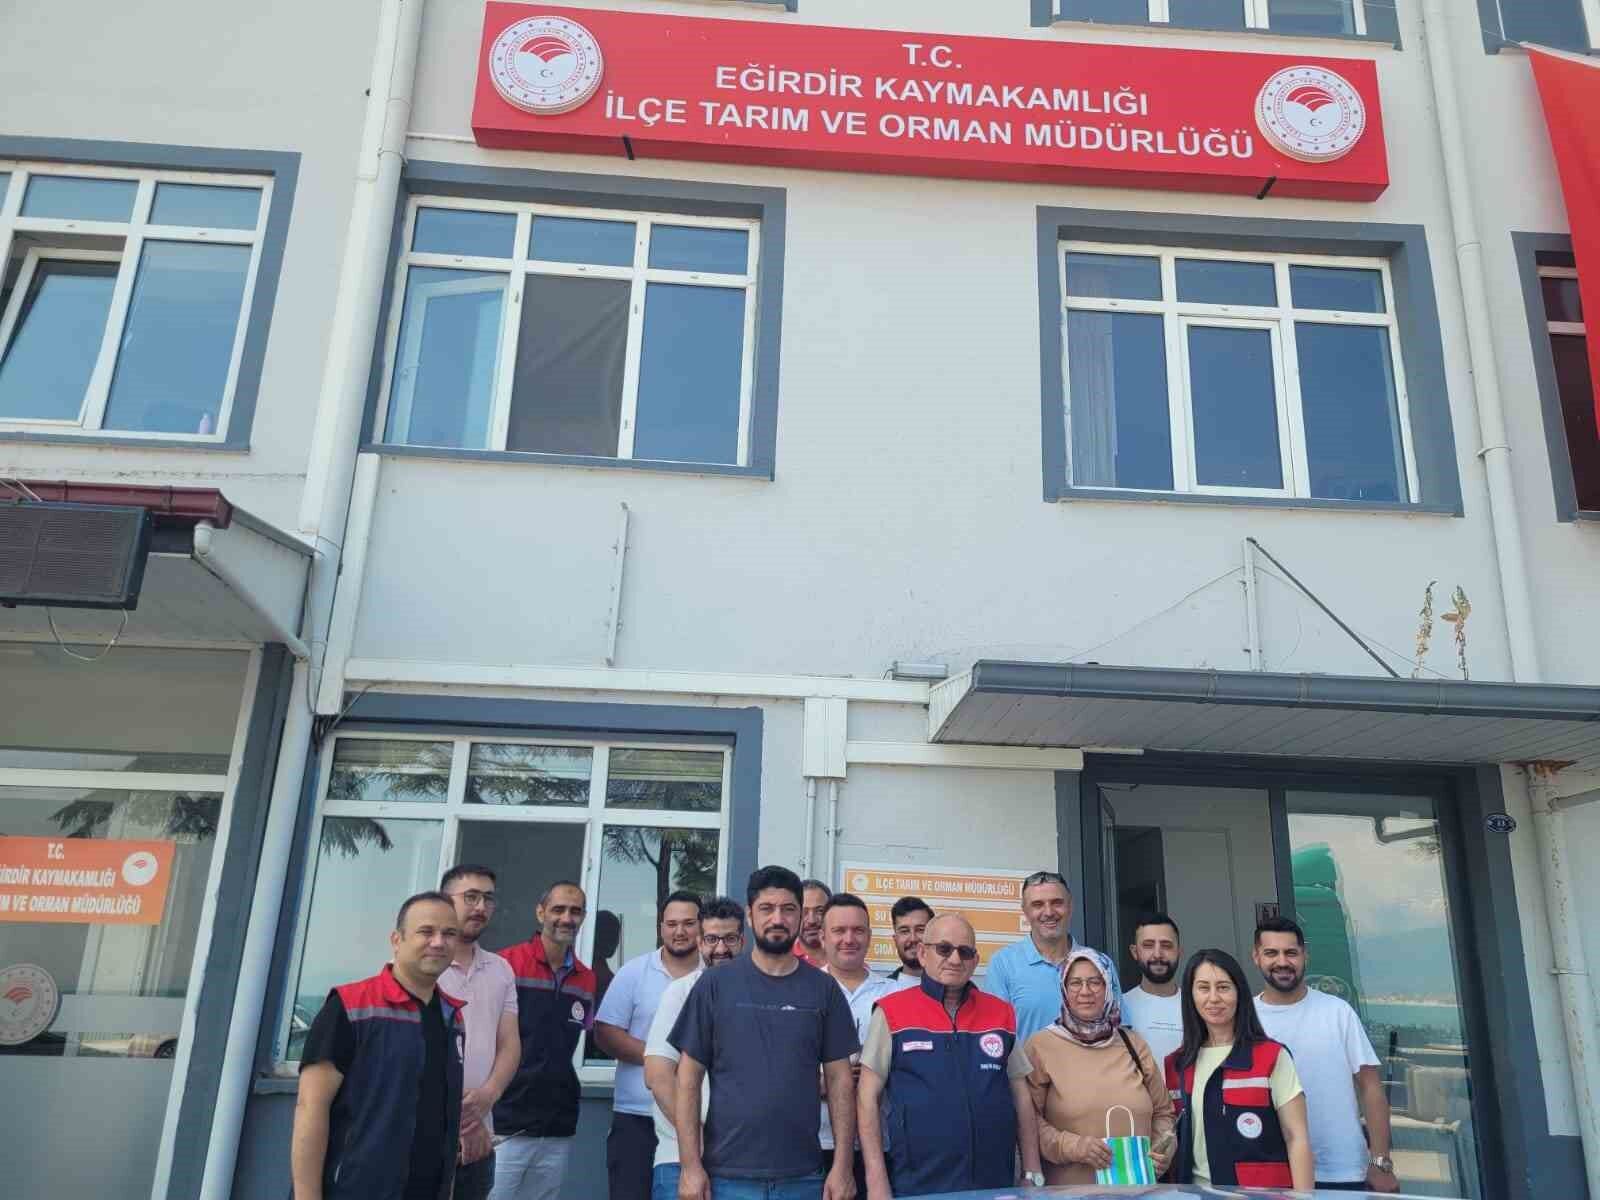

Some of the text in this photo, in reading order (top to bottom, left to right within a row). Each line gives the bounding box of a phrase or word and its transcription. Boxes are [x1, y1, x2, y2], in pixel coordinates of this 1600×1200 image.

[902, 43, 962, 69] T.C.
[715, 63, 1149, 116] EĞİRDİR KAYMAKAMLIĞI
[604, 89, 1254, 159] İLÇE TARIM VE ORMAN MÜDÜRLÜĞÜ
[31, 866, 117, 888] KAYMAKAMLIĞI
[921, 880, 932, 890] VE
[30, 896, 70, 913] ORMAN
